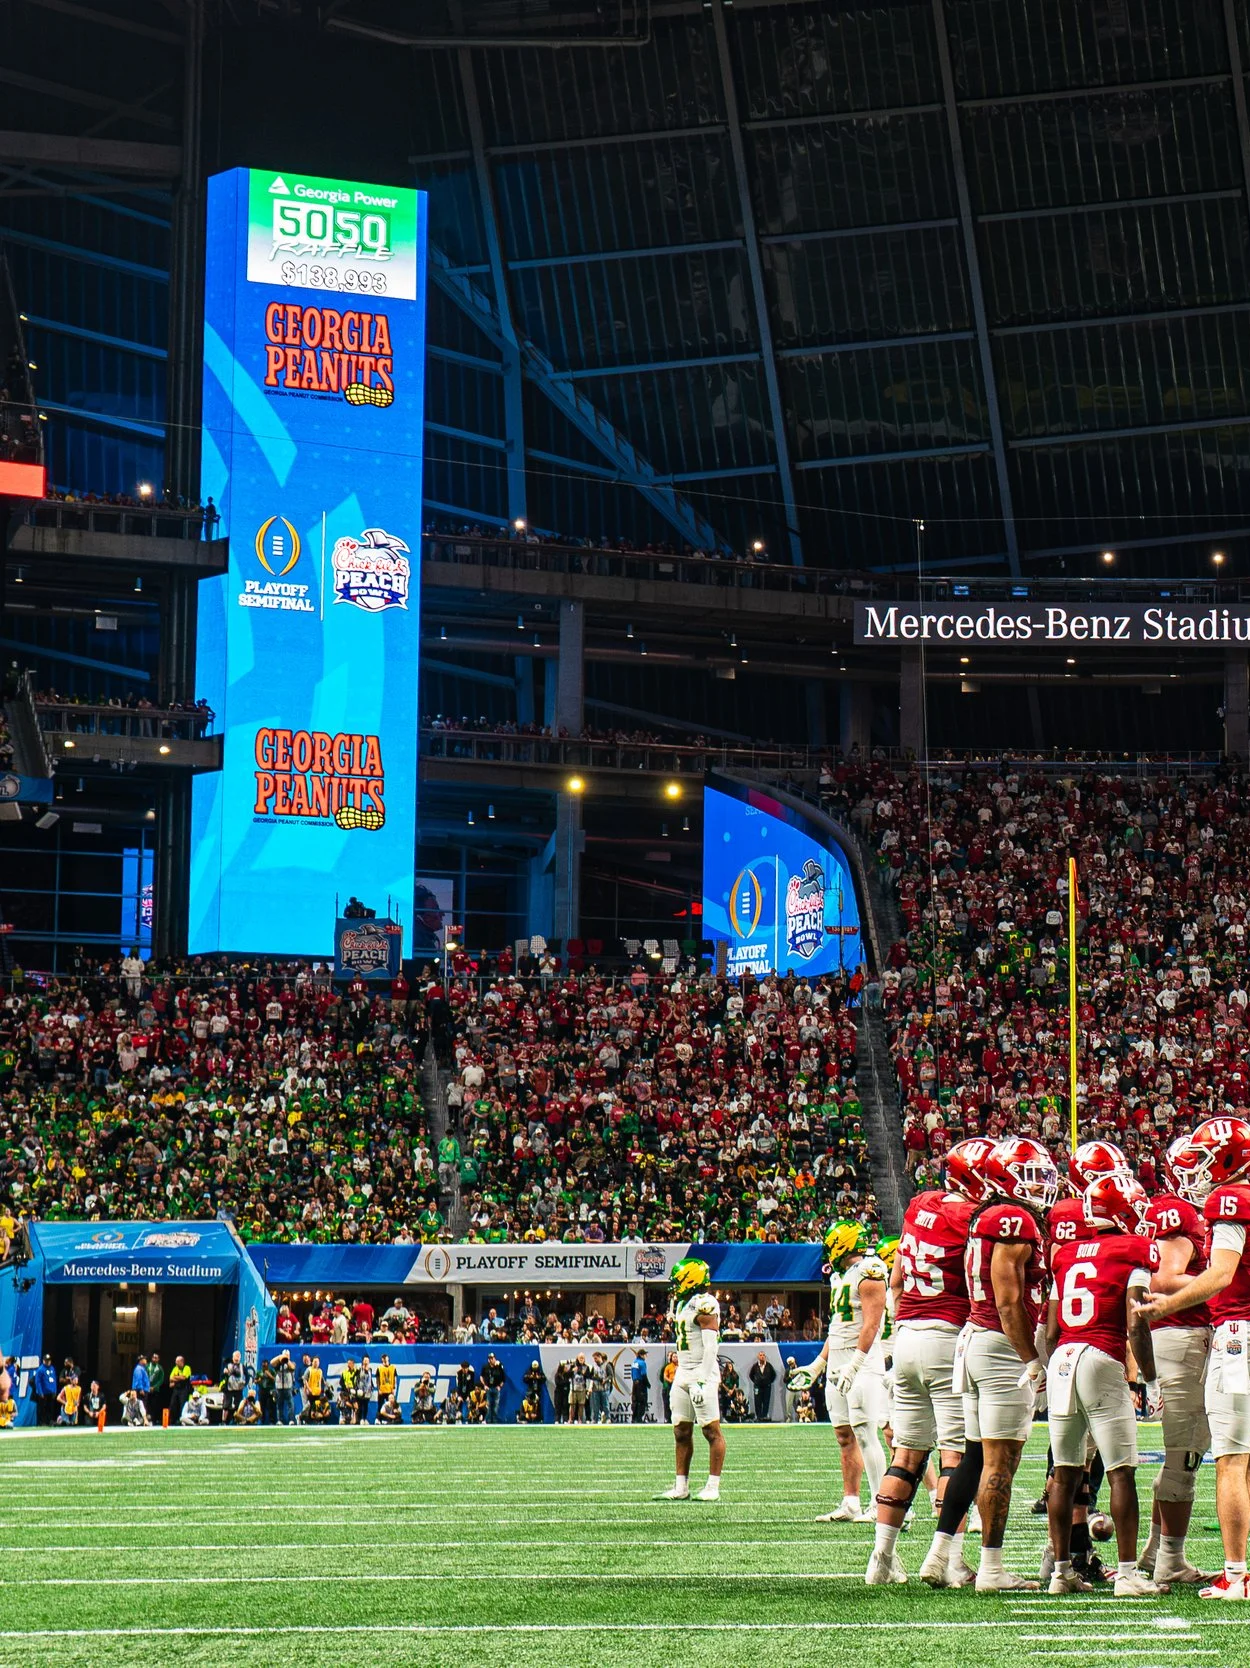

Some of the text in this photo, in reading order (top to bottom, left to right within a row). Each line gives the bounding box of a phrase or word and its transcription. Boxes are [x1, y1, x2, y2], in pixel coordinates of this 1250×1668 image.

[294, 184, 398, 208] Georgia Power
[268, 240, 394, 261] RAFFLE
[281, 261, 387, 293] $138,993
[265, 301, 392, 356] GEORGIA
[264, 345, 394, 393] PEANUTS
[245, 580, 309, 597] PLAYOFF
[337, 570, 406, 595] PEACH
[238, 594, 315, 612] SEMIFINAL
[349, 588, 391, 599] BOWL
[863, 606, 1131, 640] Mercedes-Benz
[255, 727, 384, 777] GEORGIA
[254, 771, 385, 818] PEANUTS
[787, 913, 823, 939] PEACH
[795, 932, 817, 944] BOWL
[343, 950, 387, 961] PEACH
[1219, 1195, 1238, 1216] 15
[999, 1217, 1023, 1237] 37
[1157, 1208, 1181, 1230] 78
[1056, 1222, 1076, 1240] 62
[456, 1255, 621, 1269] PLAYOFF SEMIFINAL
[1149, 1244, 1158, 1263] 6
[63, 1263, 222, 1277] Mercedes-Benz Stadium
[1062, 1262, 1097, 1327] 6
